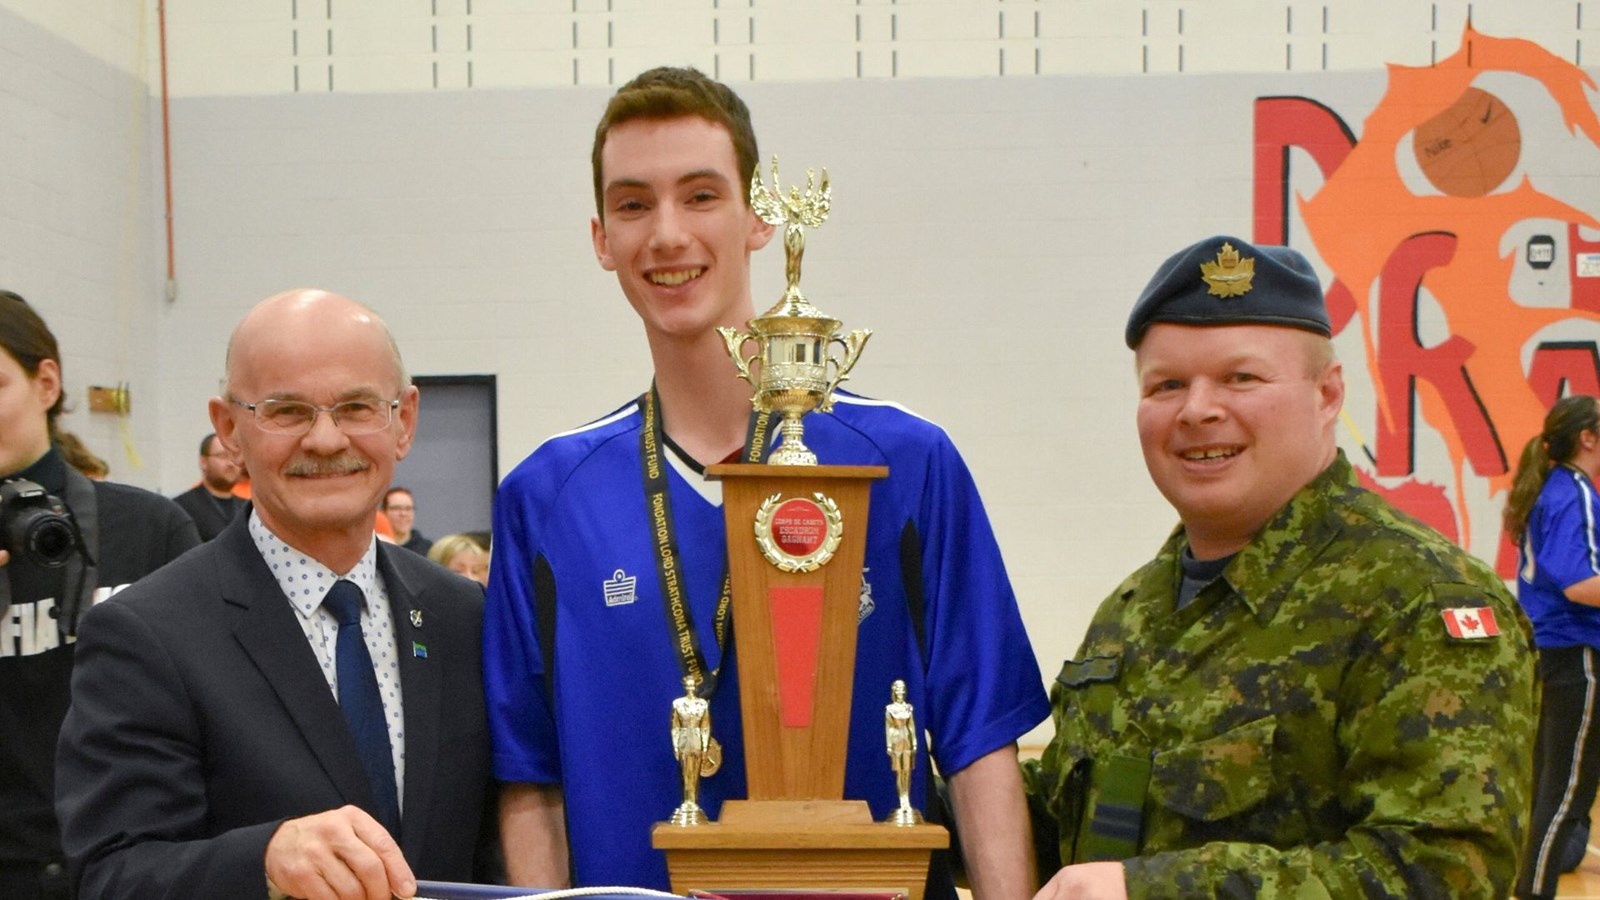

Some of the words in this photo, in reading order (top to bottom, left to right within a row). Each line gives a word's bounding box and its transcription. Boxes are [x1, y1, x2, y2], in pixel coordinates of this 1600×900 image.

[644, 427, 656, 453] TRUST
[749, 411, 769, 462] FONDATION
[647, 454, 660, 479] FUND
[653, 493, 669, 544] FONDATION
[779, 526, 820, 535] ESCADRON
[660, 544, 674, 570] LORD
[664, 569, 687, 631] STRATHCONA
[716, 597, 730, 621] LORD
[679, 630, 694, 658] TRUST
[686, 659, 704, 685] FUND
